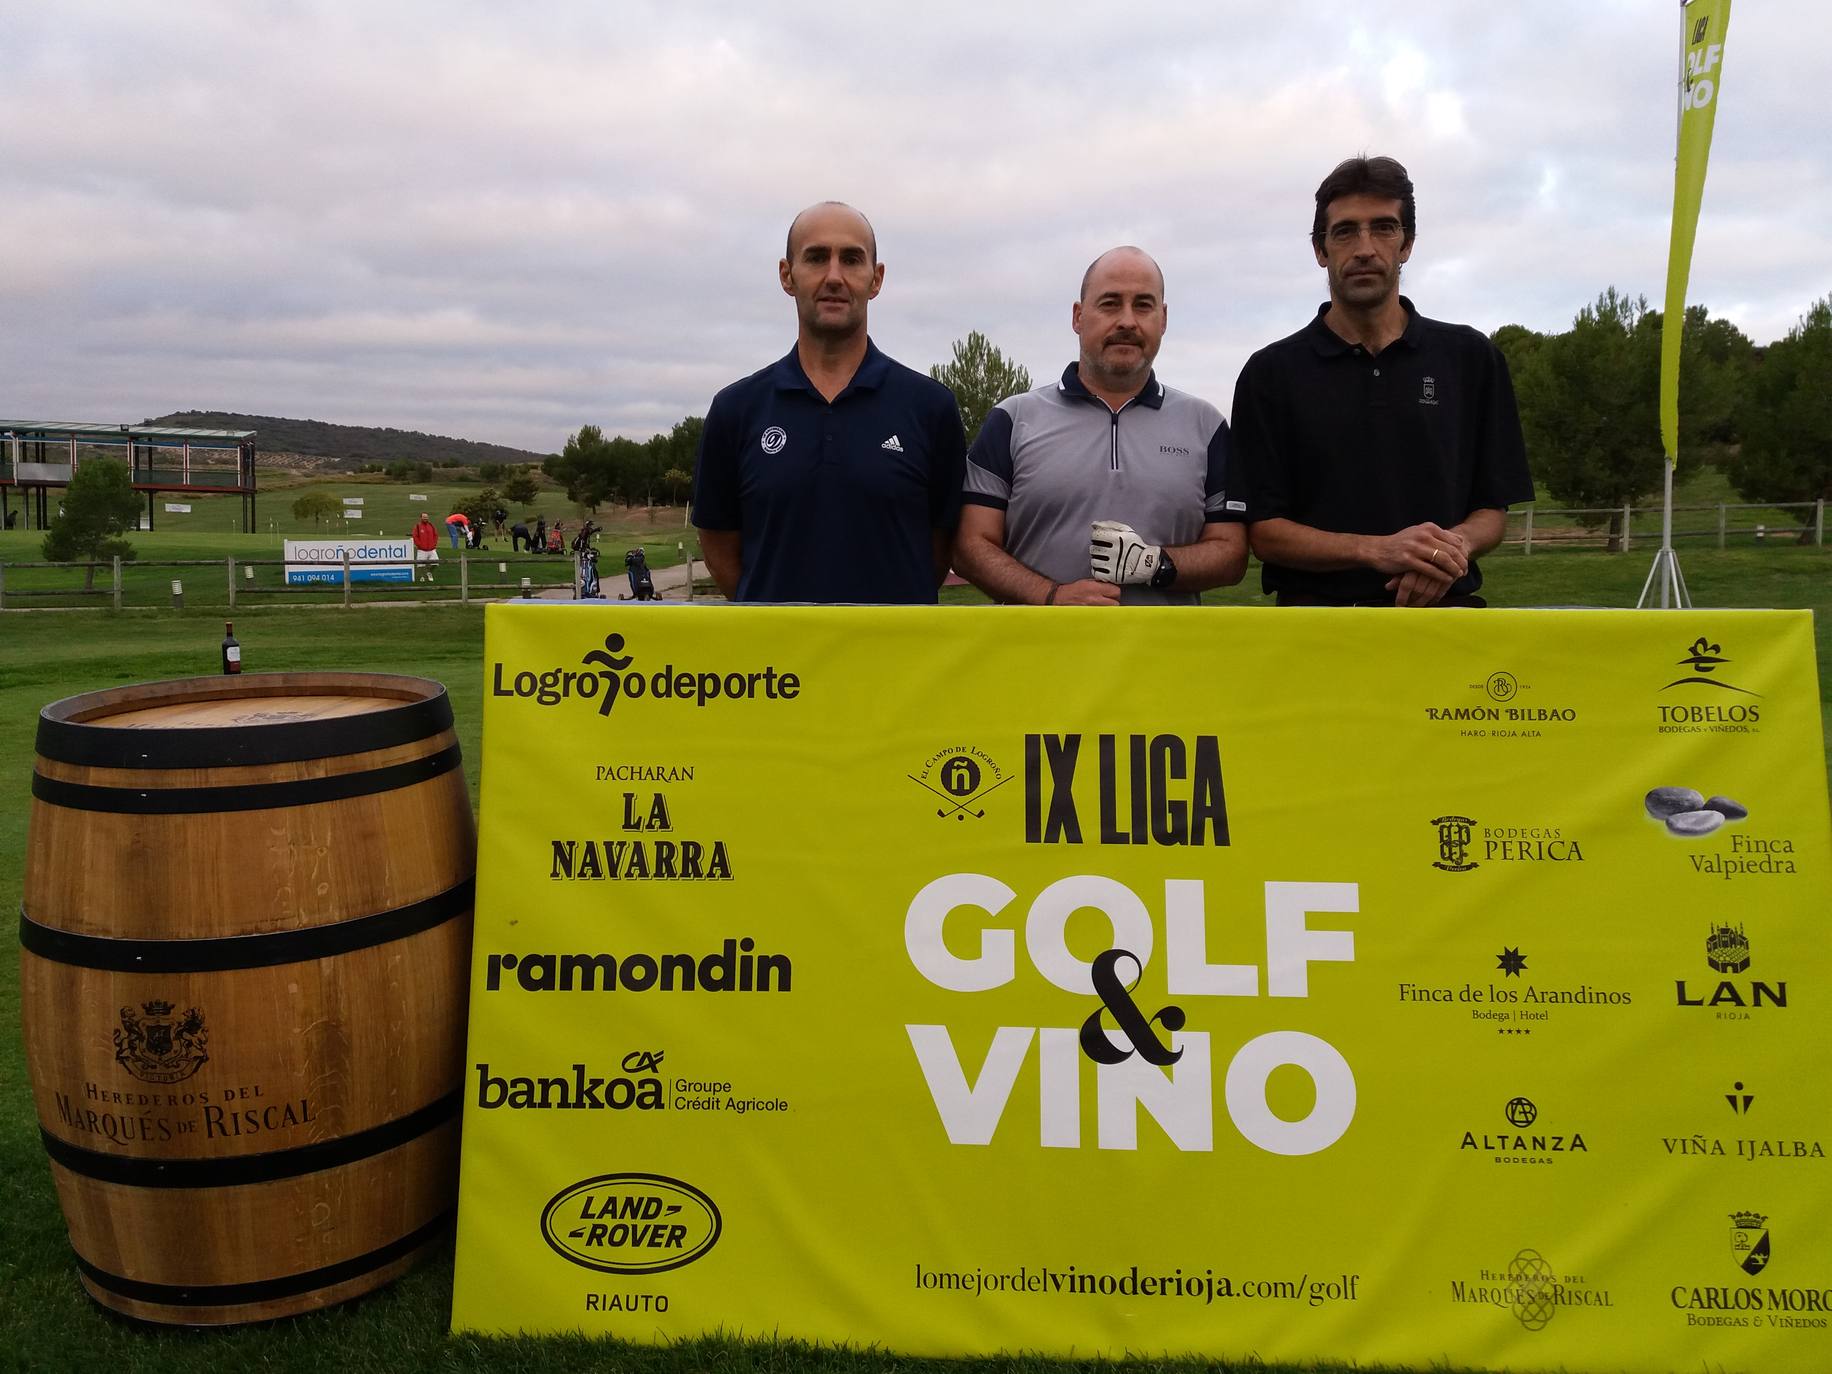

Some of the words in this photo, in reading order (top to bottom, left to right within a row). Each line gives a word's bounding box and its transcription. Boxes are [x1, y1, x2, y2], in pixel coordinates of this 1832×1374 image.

[1159, 445, 1190, 456] BOSS
[307, 574, 320, 582] 094
[1425, 706, 1500, 721] RAMÓN
[1505, 708, 1577, 722] BILBAO
[1657, 704, 1760, 723] TOBELOS
[1491, 730, 1518, 738] RIOJA
[1521, 730, 1542, 738] ALTA
[1658, 725, 1702, 734] BODEGAS
[596, 765, 694, 783] PACHARAN
[925, 747, 954, 768] CAMPO
[970, 746, 1002, 780] LOGROÑO
[1025, 734, 1083, 844] IX
[1099, 734, 1231, 847] LIGA
[622, 792, 673, 832] LA
[1484, 828, 1561, 838] BODEGAS
[1731, 834, 1794, 853] Finca
[550, 840, 734, 880] NAVARRA
[1484, 840, 1585, 861] PERICA
[1689, 853, 1797, 880] Valpiedra
[904, 873, 1360, 998] GOLF
[486, 937, 792, 992] ramondin
[1398, 983, 1453, 1002] Finca
[1459, 984, 1483, 1003] de
[1489, 984, 1518, 1003] los
[1523, 985, 1632, 1005] Arandinos
[1674, 980, 1788, 1008] LAN
[1079, 948, 1186, 1066] &
[1472, 1009, 1509, 1022] Bodega
[1520, 1010, 1549, 1021] Hotel
[1716, 1012, 1751, 1020] RIOJA
[84, 1081, 209, 1107] HEREDEROS
[224, 1084, 265, 1101] DEL
[476, 1063, 665, 1110] bankoa
[675, 1078, 732, 1095] Groupe
[904, 1024, 1357, 1156] VINO
[674, 1096, 721, 1110] Crédit
[725, 1097, 788, 1114] Agricole
[55, 1091, 172, 1146] MARQUÉS
[177, 1119, 198, 1135] DE
[204, 1099, 318, 1139] RISCAL
[1460, 1131, 1588, 1152] ALTANZA
[1662, 1134, 1726, 1156] VIÑA
[1736, 1140, 1825, 1161] IJALBA
[1495, 1156, 1553, 1164] BODEGAS
[580, 1196, 663, 1220] LAND
[585, 1223, 688, 1248] ROVER
[915, 1263, 1361, 1307] lomejordelvinoderioja.com/golf
[1564, 1274, 1586, 1284] DEL
[586, 1293, 669, 1313] RIAUTO
[1451, 1280, 1536, 1309] MARQUÉS
[1552, 1284, 1614, 1307] RISCAL
[1671, 1286, 1763, 1310] CARLOS
[1687, 1312, 1749, 1327] BODEGAS
[1753, 1315, 1764, 1327] &
[1766, 1314, 1828, 1328] VIÑEDOS
